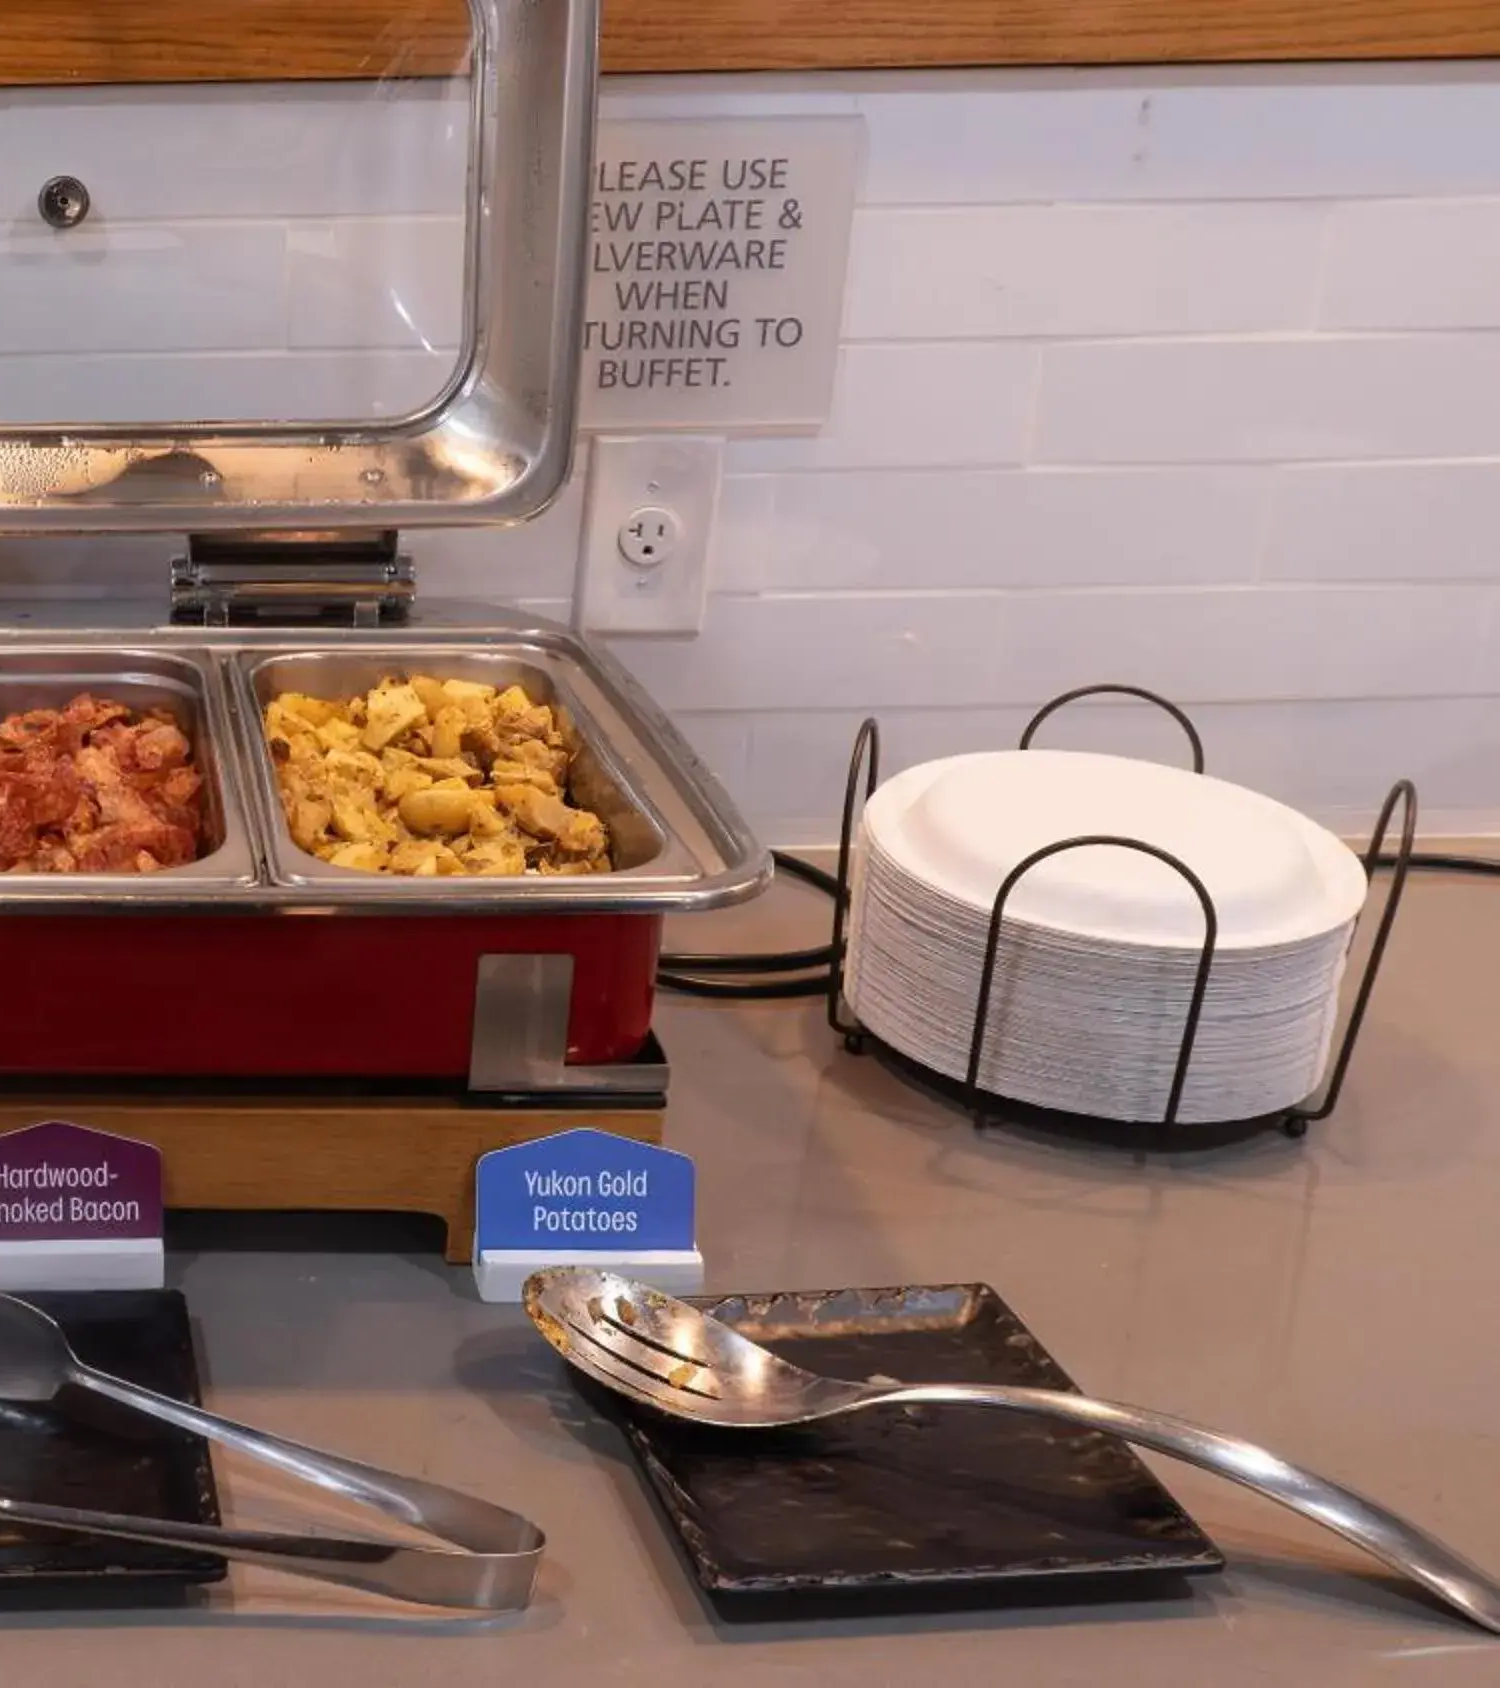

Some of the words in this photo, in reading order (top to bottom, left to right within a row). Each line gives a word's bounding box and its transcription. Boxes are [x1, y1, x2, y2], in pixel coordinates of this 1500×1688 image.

[594, 159, 708, 192] LEASE
[722, 158, 789, 190] USE
[591, 200, 644, 233] EW
[655, 198, 764, 232] PLATE
[778, 198, 803, 230] &
[593, 239, 788, 272] LVERWARE
[615, 280, 729, 311] WHEN
[582, 319, 741, 350] TURNING
[755, 317, 804, 348] TO
[598, 357, 731, 389] BUFFET.
[524, 1170, 591, 1198] Yukon
[598, 1170, 648, 1197] Gold
[69, 1197, 141, 1222] Bacon
[533, 1206, 638, 1233] Potatoes
